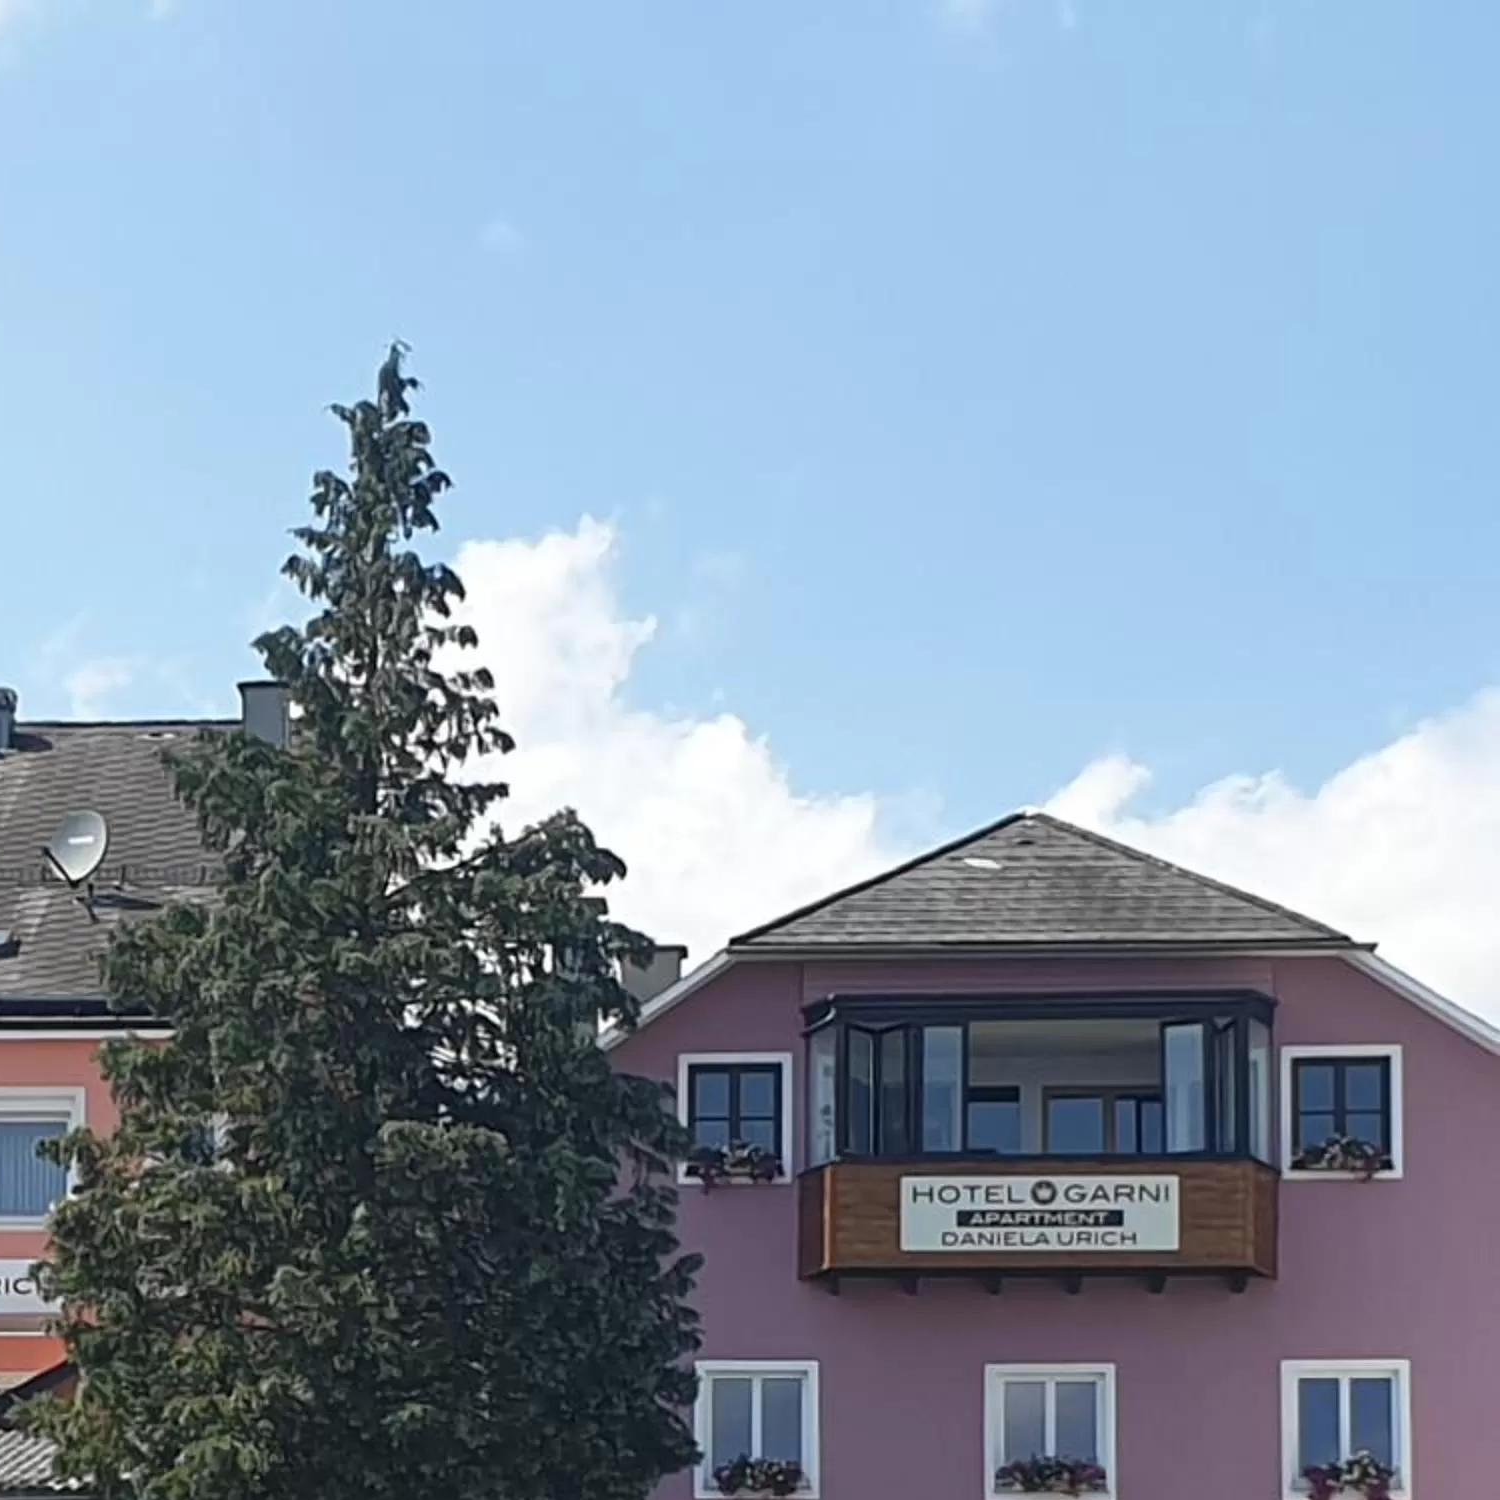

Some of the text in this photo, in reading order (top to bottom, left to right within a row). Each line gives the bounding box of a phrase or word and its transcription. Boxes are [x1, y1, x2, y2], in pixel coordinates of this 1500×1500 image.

[912, 1184, 1169, 1204] HOTEL GARNI
[969, 1210, 1109, 1225] APARTMENT
[941, 1231, 1137, 1247] DANIELA URICH
